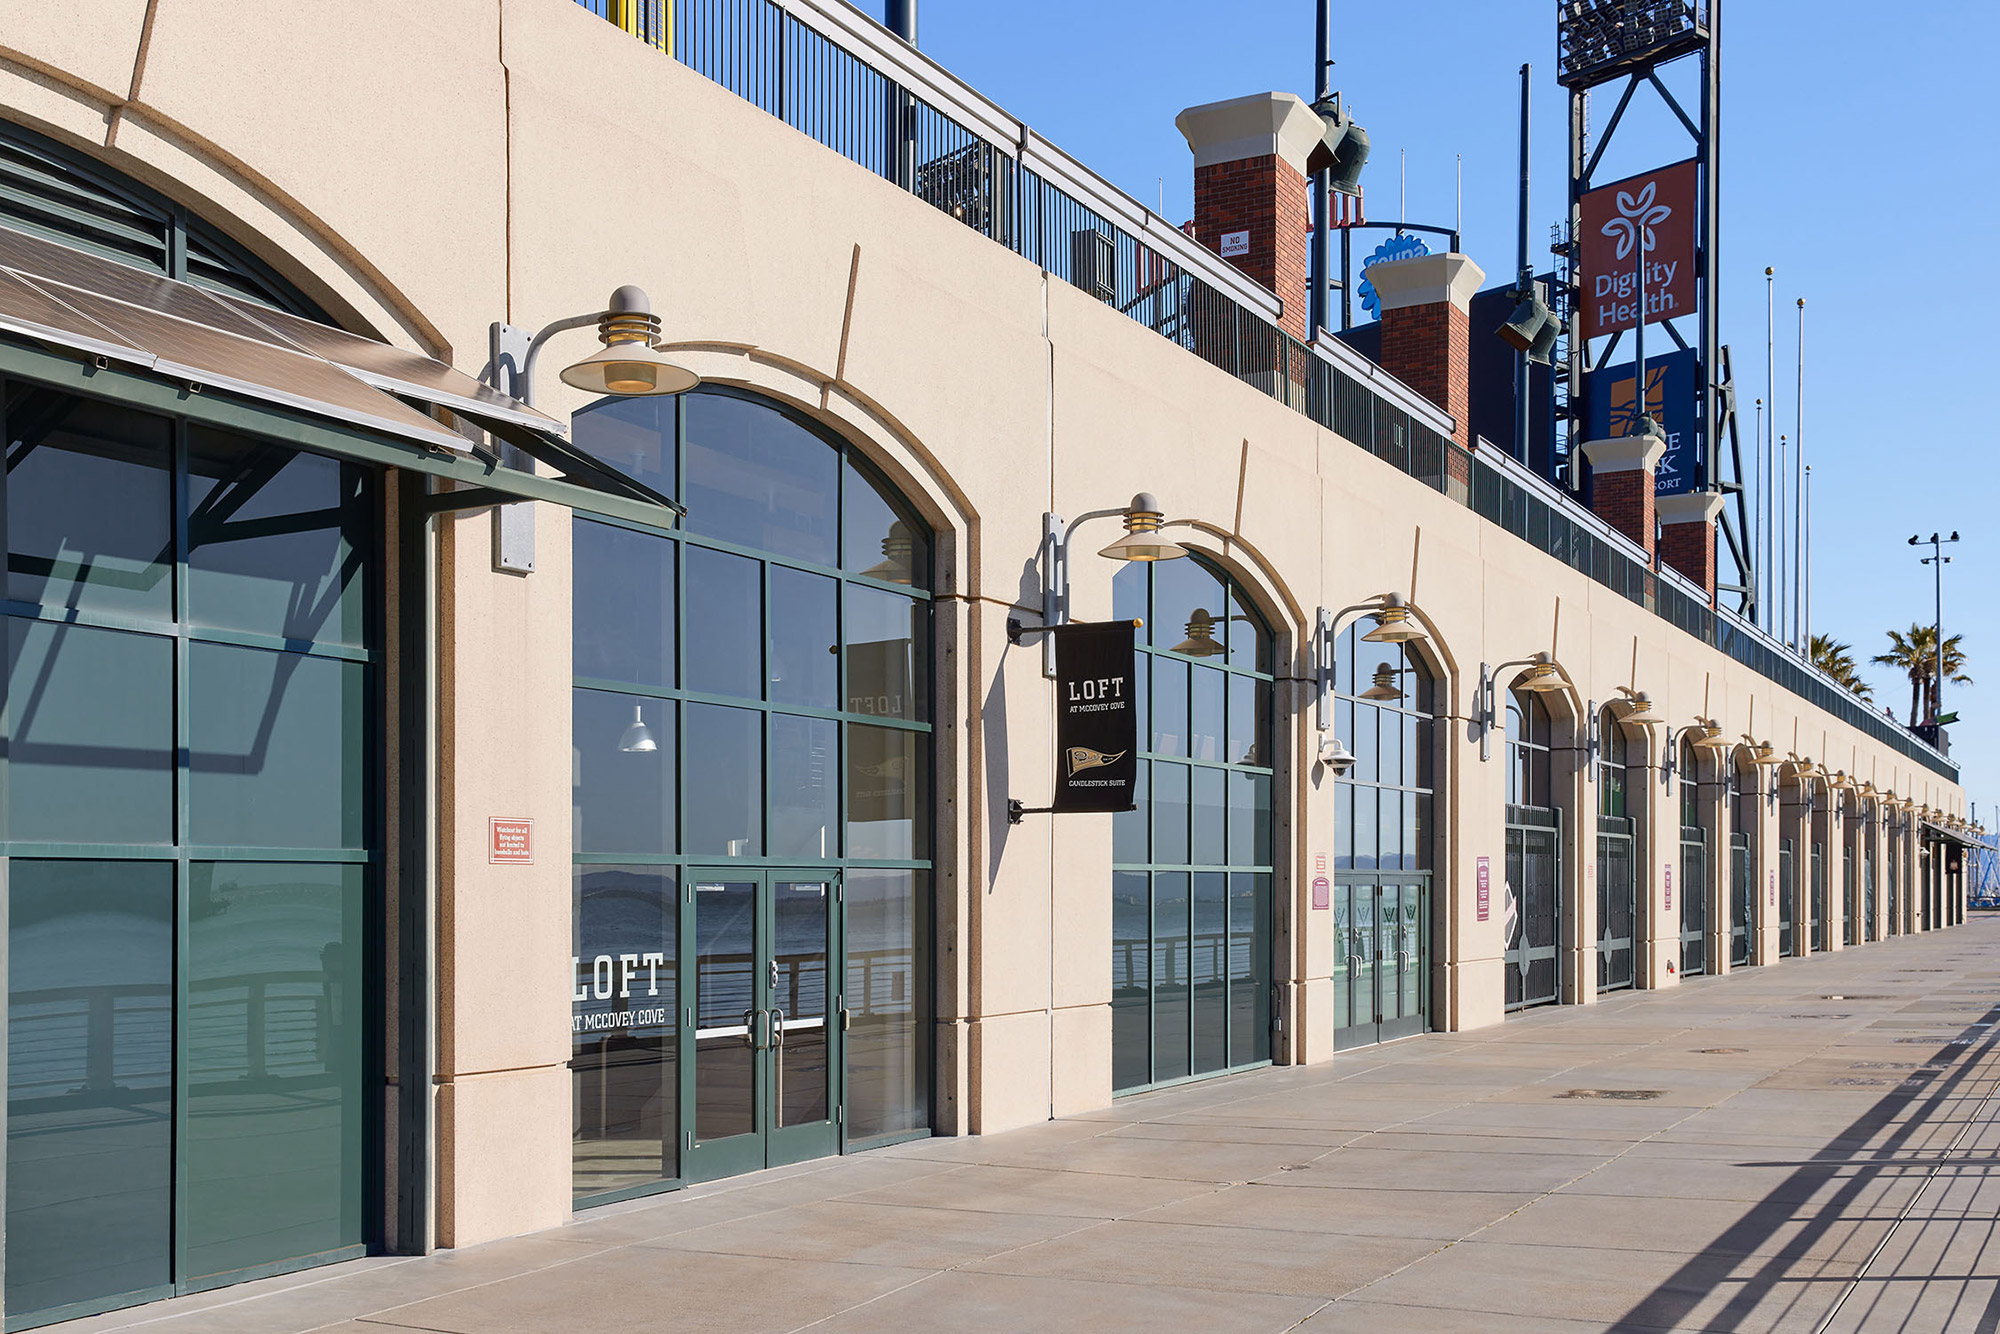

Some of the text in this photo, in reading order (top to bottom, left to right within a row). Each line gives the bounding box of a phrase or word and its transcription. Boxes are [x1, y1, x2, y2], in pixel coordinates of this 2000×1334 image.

[1222, 243, 1247, 253] SMOKING
[1230, 236, 1240, 244] NO
[1068, 677, 1124, 701] LOFT
[1070, 701, 1125, 713] AT MCCOVEY COVE
[572, 952, 664, 1001] LOFT
[572, 1008, 665, 1031] AT MCCOVEY COVE
